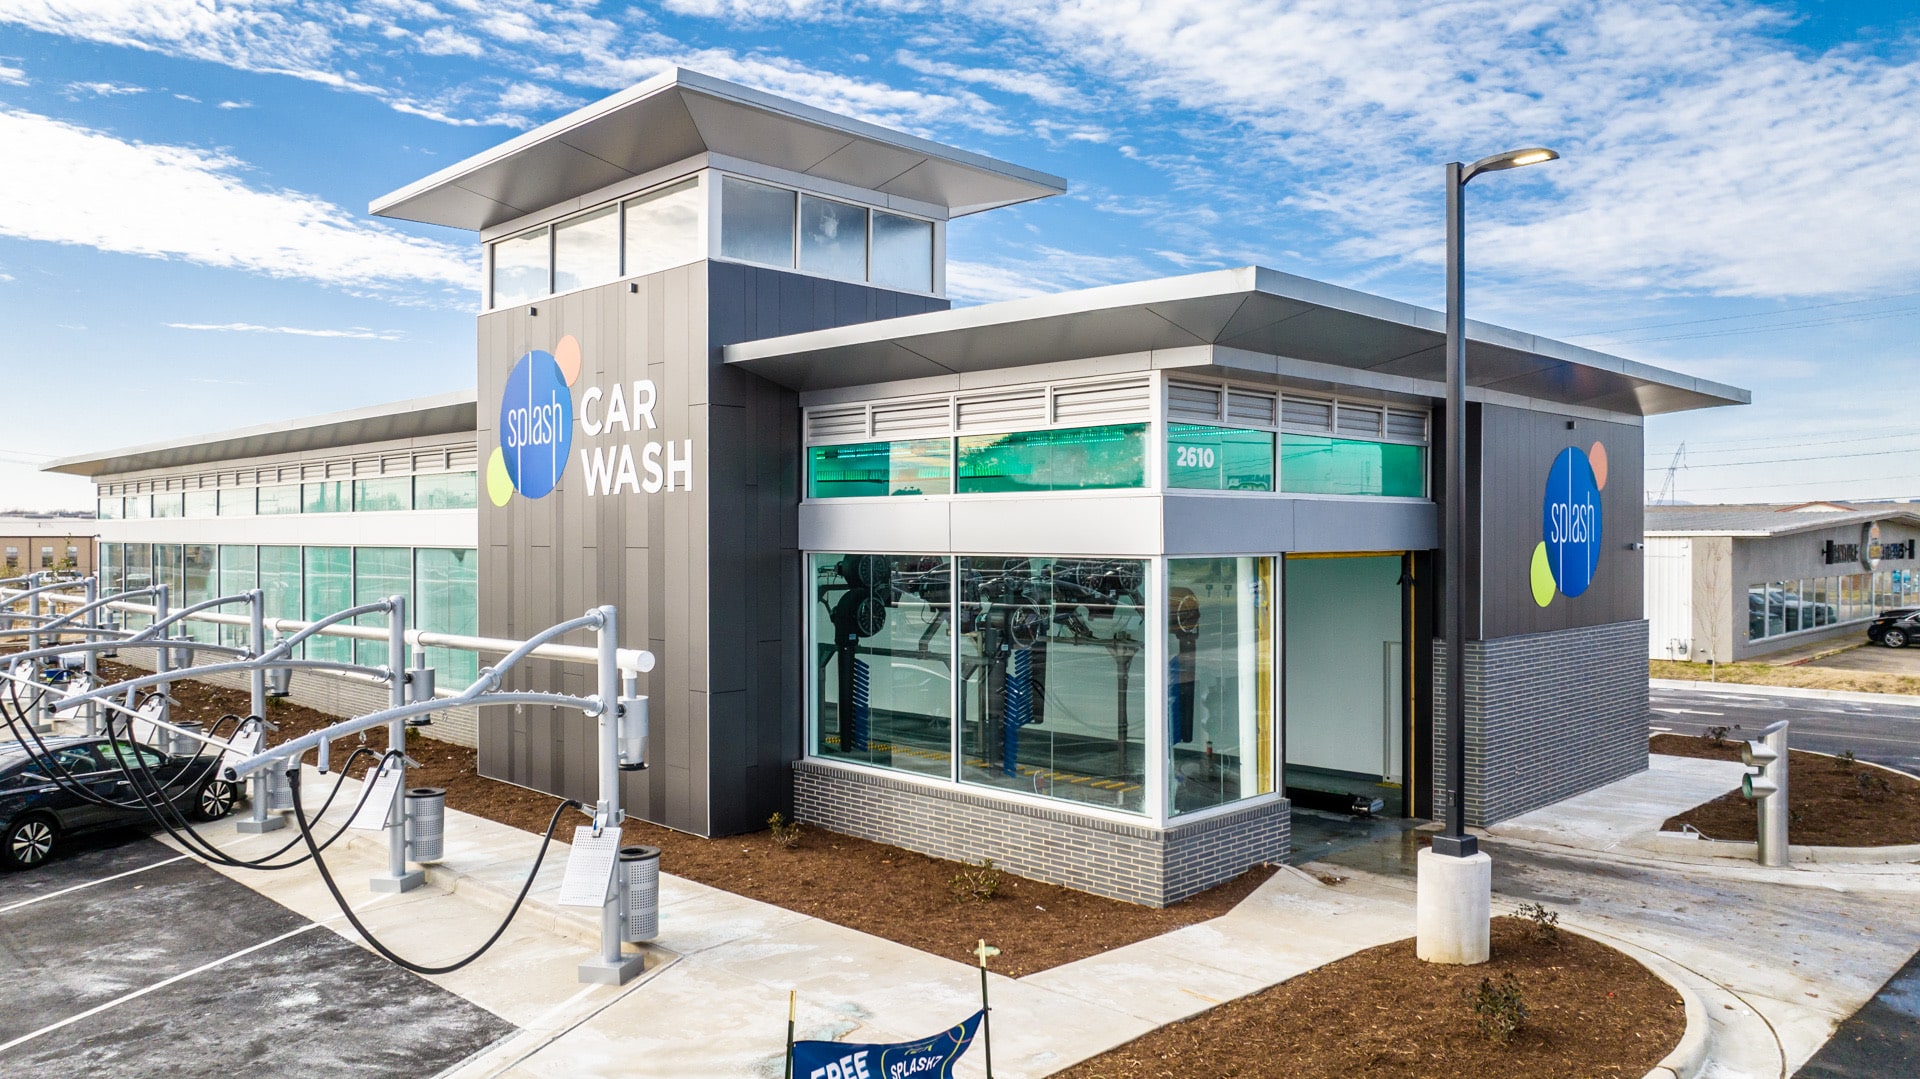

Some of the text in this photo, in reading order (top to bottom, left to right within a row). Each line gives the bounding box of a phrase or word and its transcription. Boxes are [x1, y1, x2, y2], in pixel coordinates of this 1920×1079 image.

[507, 351, 563, 494] splash
[580, 379, 657, 437] CAR
[580, 439, 693, 497] WASH
[1176, 446, 1215, 468] 2610
[1551, 447, 1595, 592] splash
